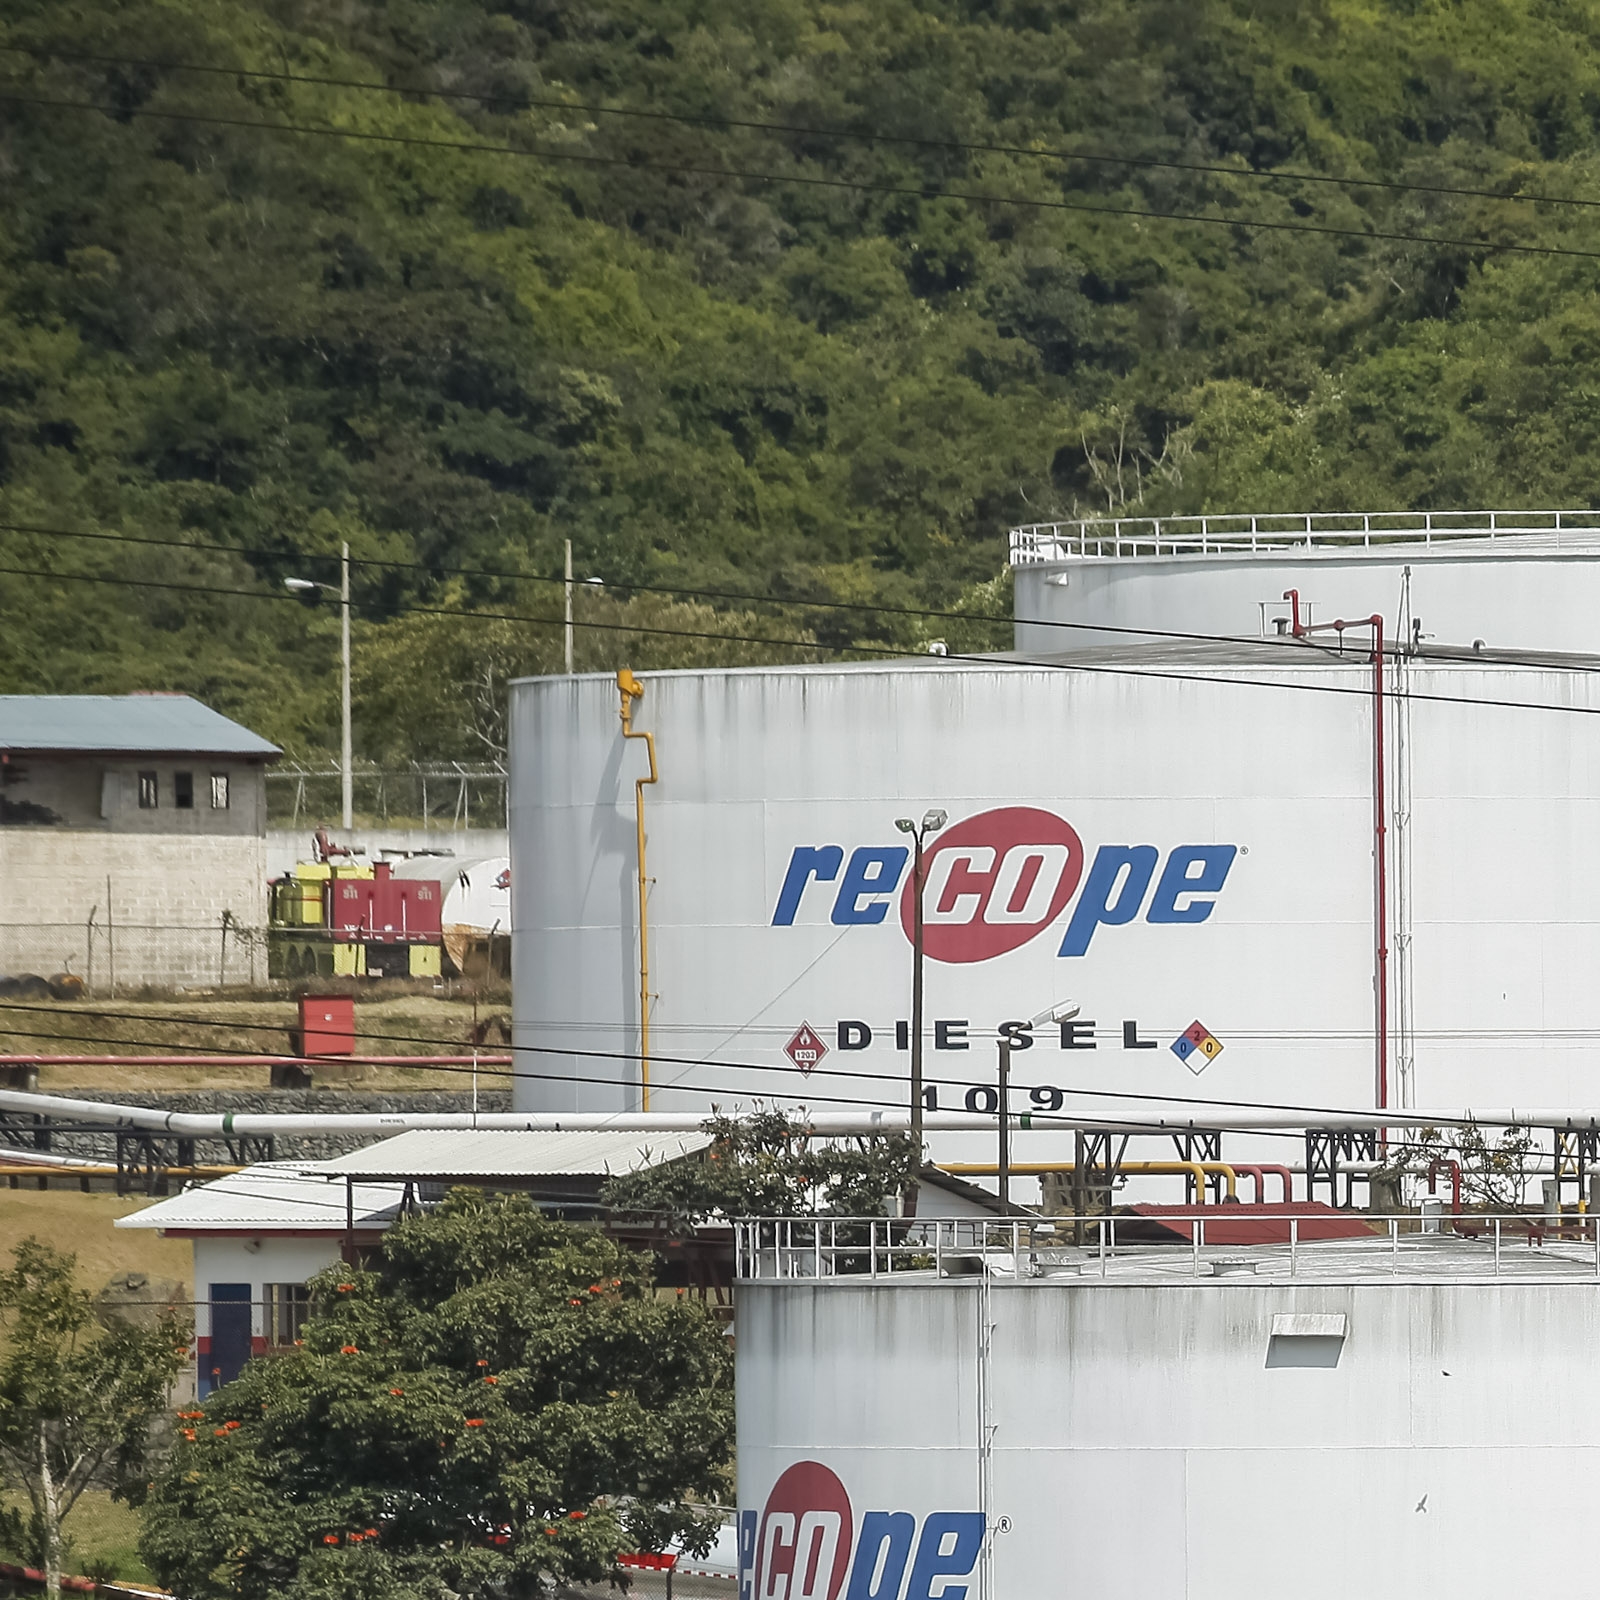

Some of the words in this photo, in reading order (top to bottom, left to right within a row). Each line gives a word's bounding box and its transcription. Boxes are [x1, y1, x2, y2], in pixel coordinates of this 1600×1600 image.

[771, 844, 1238, 957] recope
[837, 1020, 1158, 1051] DIESEL
[921, 1086, 1064, 1112] 109
